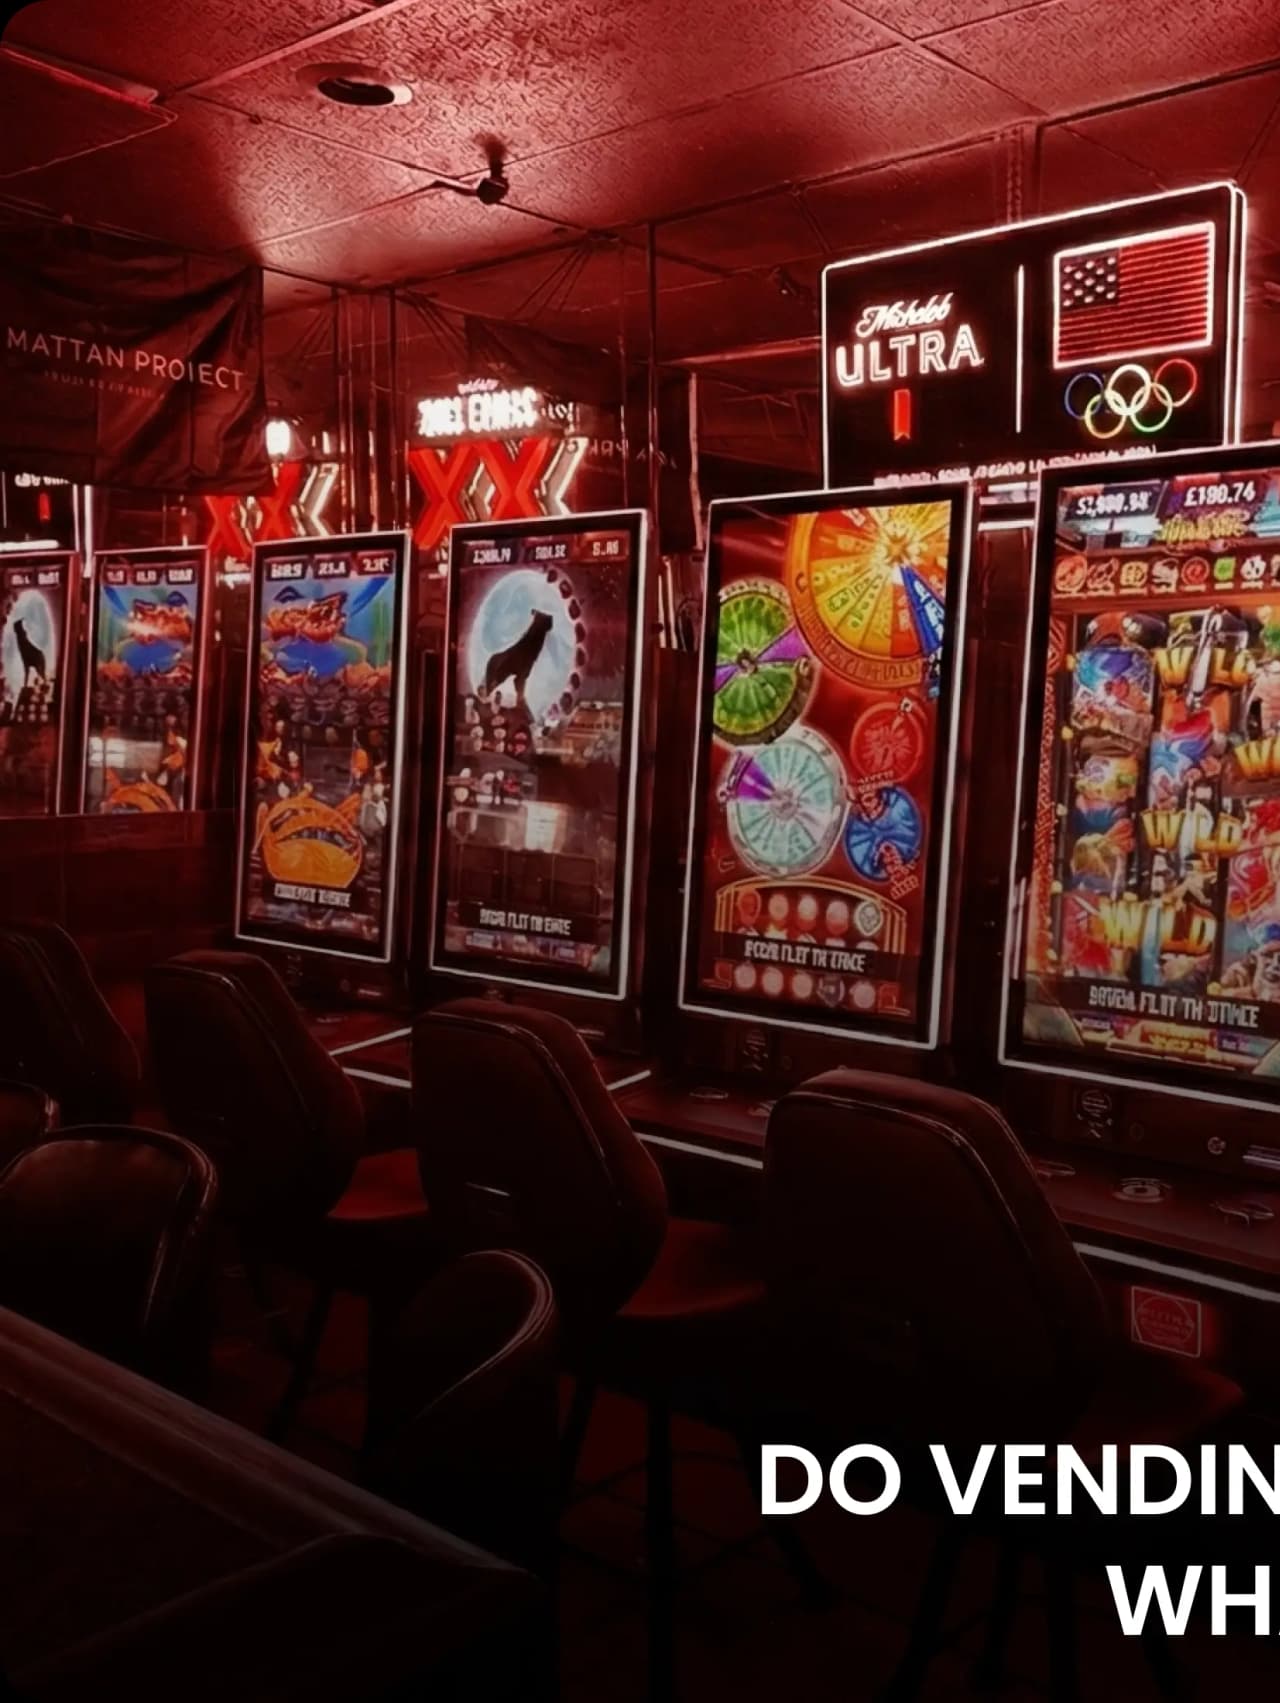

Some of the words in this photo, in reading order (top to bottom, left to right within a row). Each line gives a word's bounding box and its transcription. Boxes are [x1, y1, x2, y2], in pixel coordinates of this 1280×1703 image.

[7, 327, 124, 369] MATTAN
[835, 323, 985, 388] ULTRA
[1154, 646, 1253, 687] WLD
[1141, 809, 1243, 853] WLD
